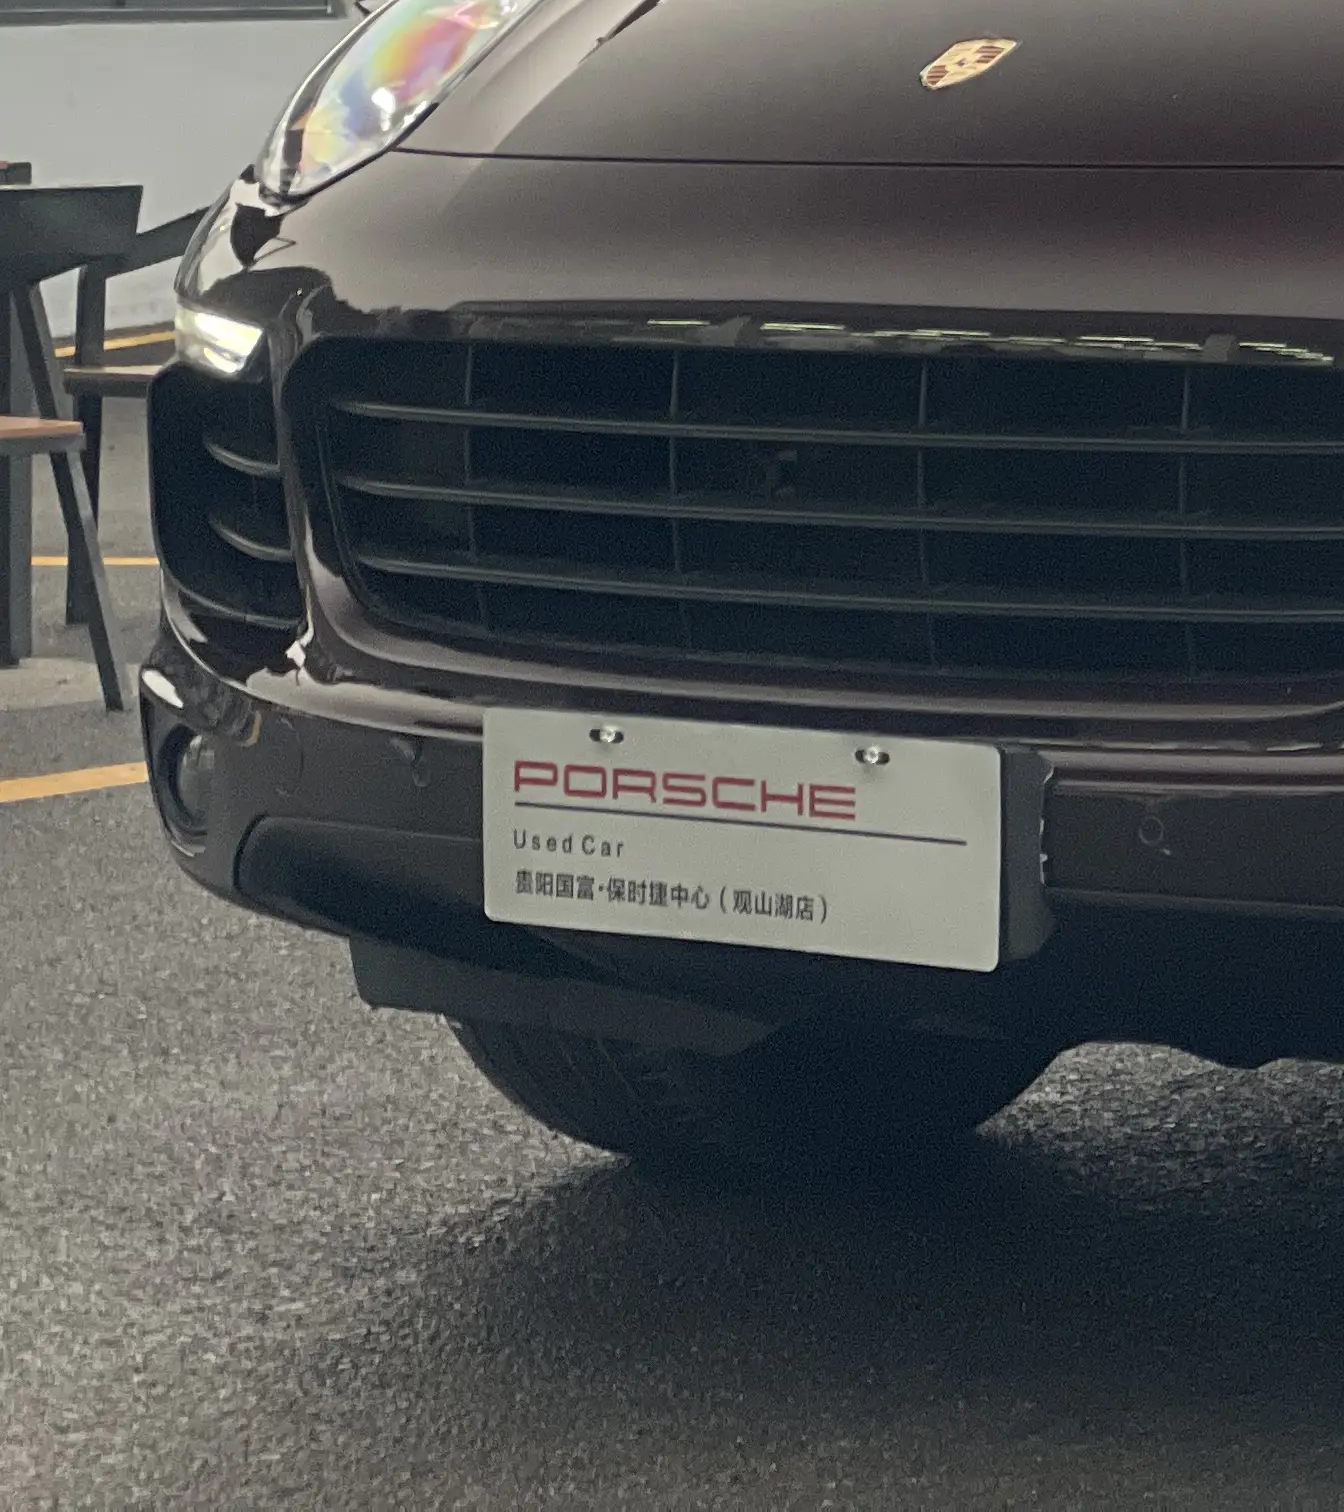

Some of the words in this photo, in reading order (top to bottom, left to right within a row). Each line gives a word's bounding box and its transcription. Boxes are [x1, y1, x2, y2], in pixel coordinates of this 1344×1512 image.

[514, 760, 857, 821] PORSCHE
[513, 828, 573, 854] Used
[581, 834, 625, 858] Car
